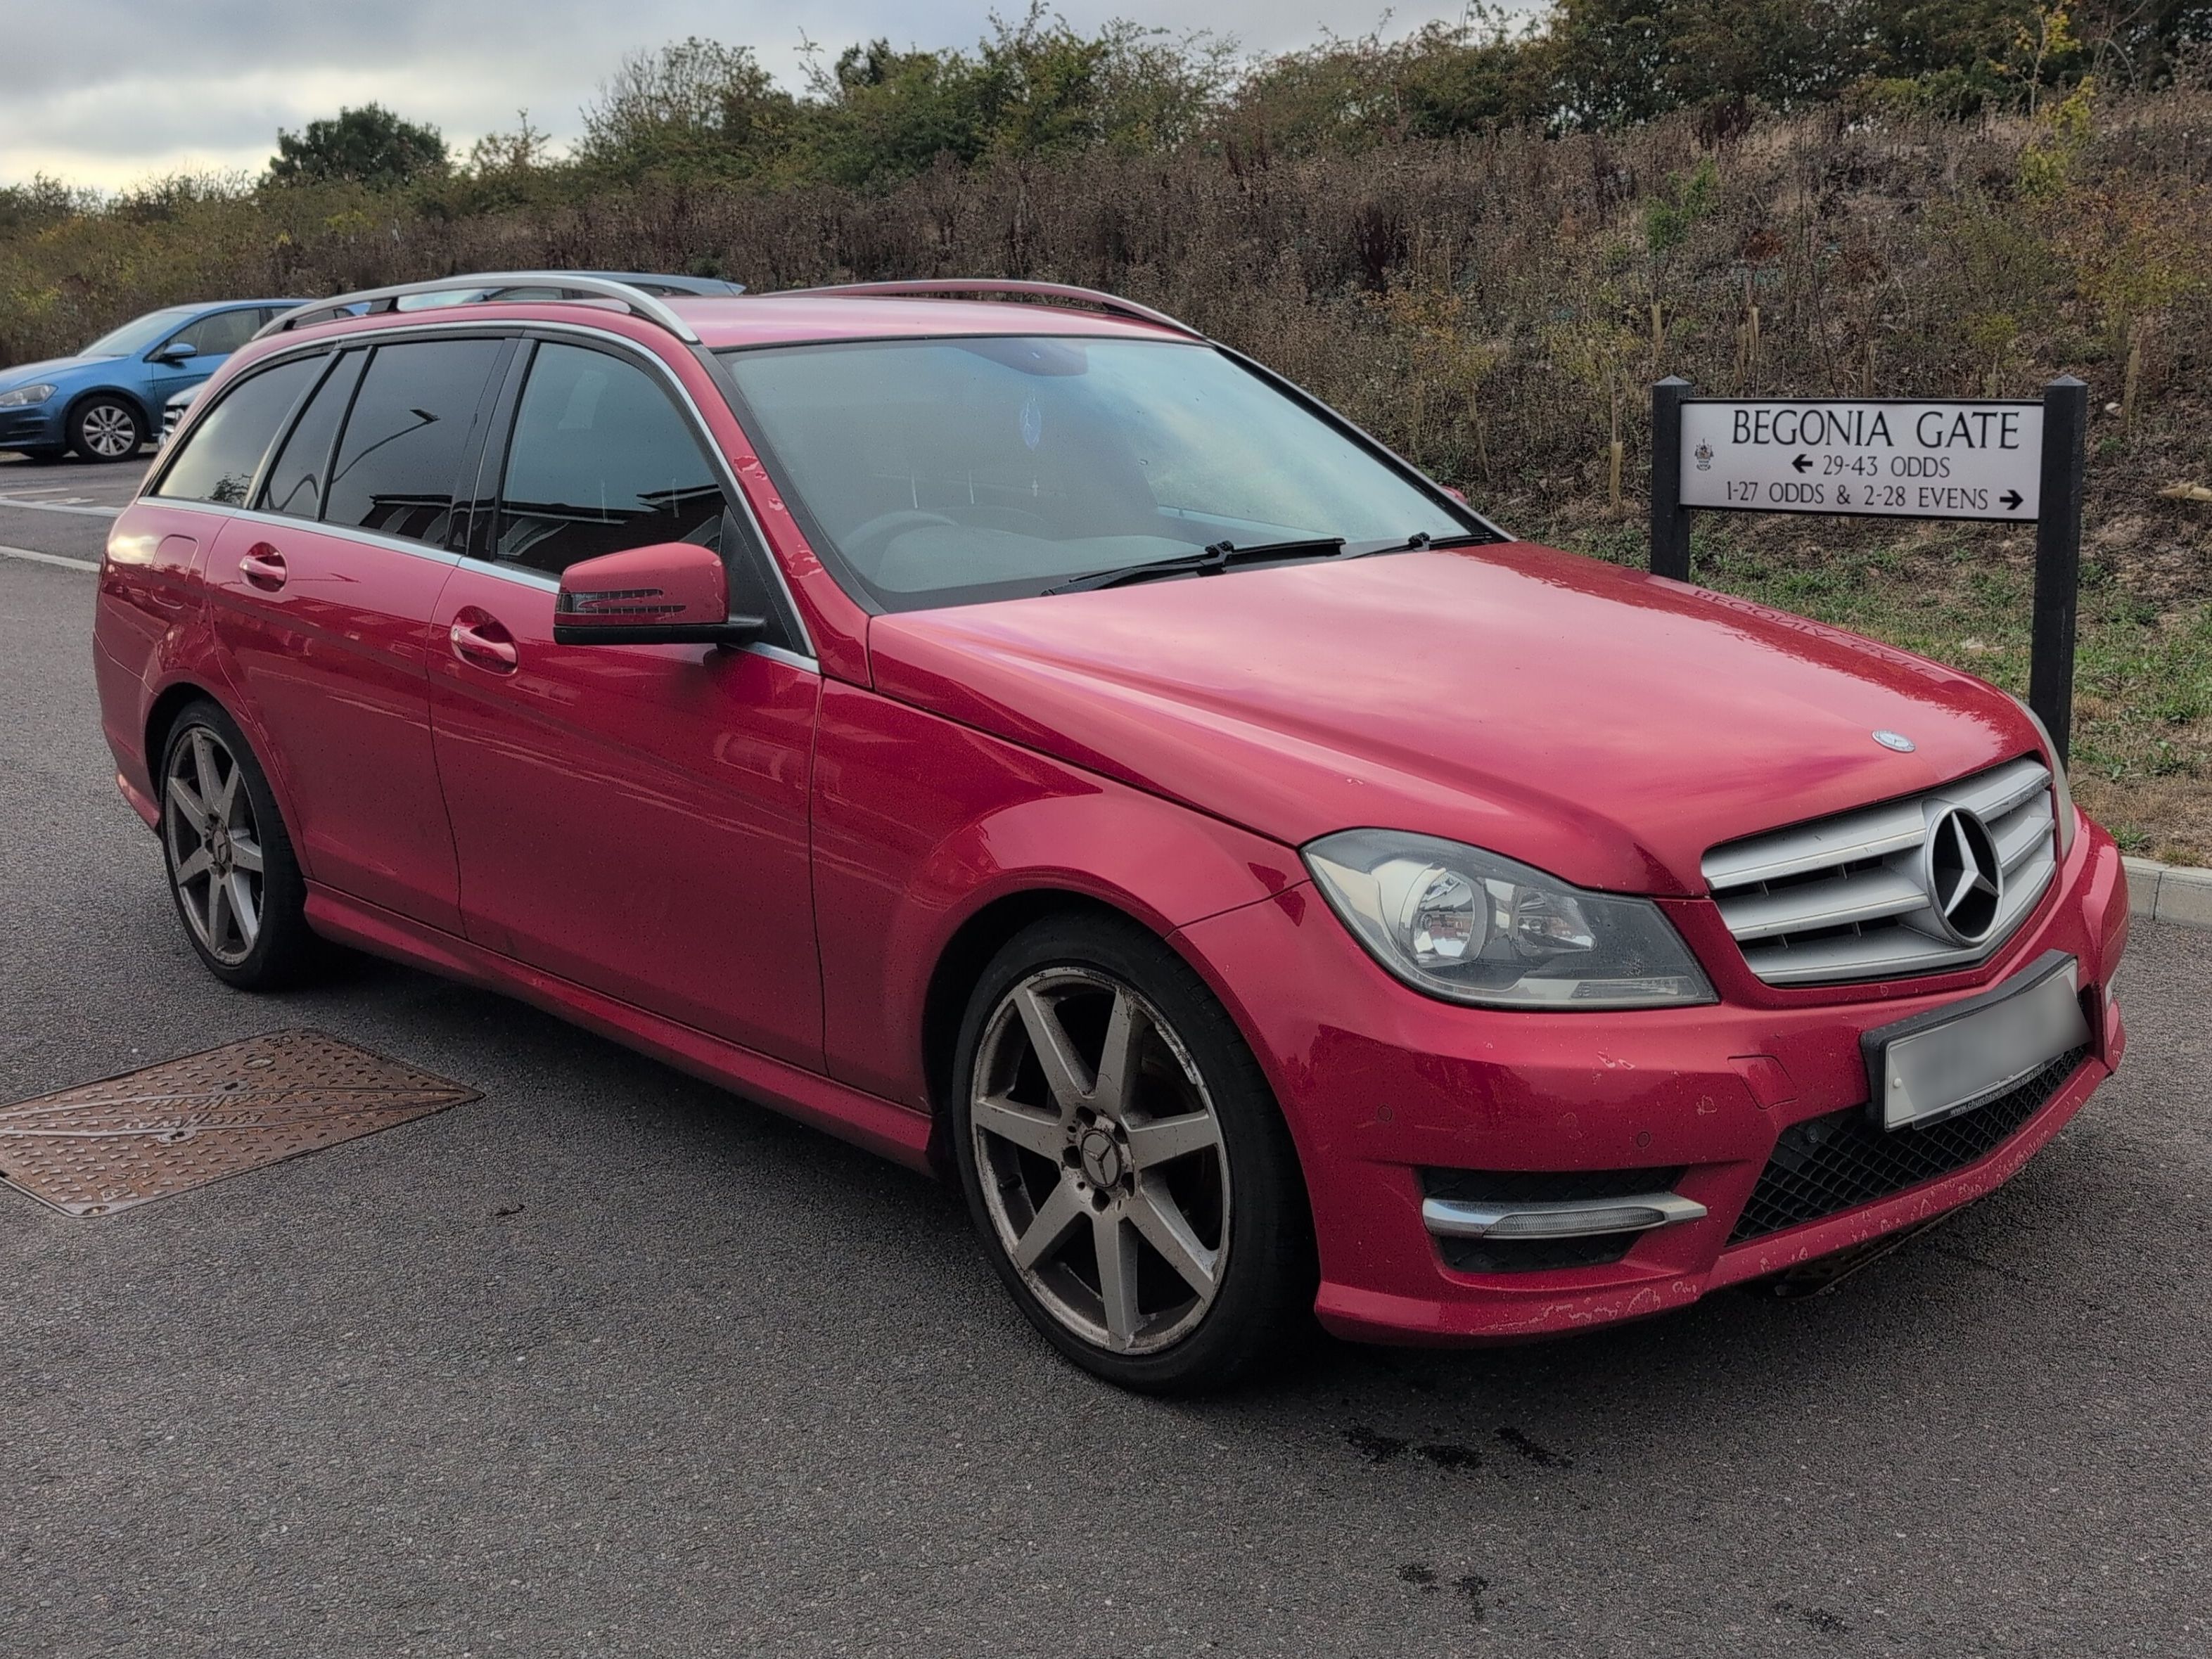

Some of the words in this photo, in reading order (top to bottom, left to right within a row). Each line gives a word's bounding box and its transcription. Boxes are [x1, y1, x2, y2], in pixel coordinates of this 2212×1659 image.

[1731, 409, 1895, 447] BEGONIA
[1916, 411, 2020, 450] GATE
[1822, 454, 1878, 477] 29-43
[1890, 456, 1950, 479] ODDS
[1727, 480, 1758, 502] 1-27
[1768, 482, 1824, 504] ODDS
[1836, 484, 1851, 506] &
[1864, 485, 1906, 507] 2-28
[1918, 487, 1988, 511] EVENS
